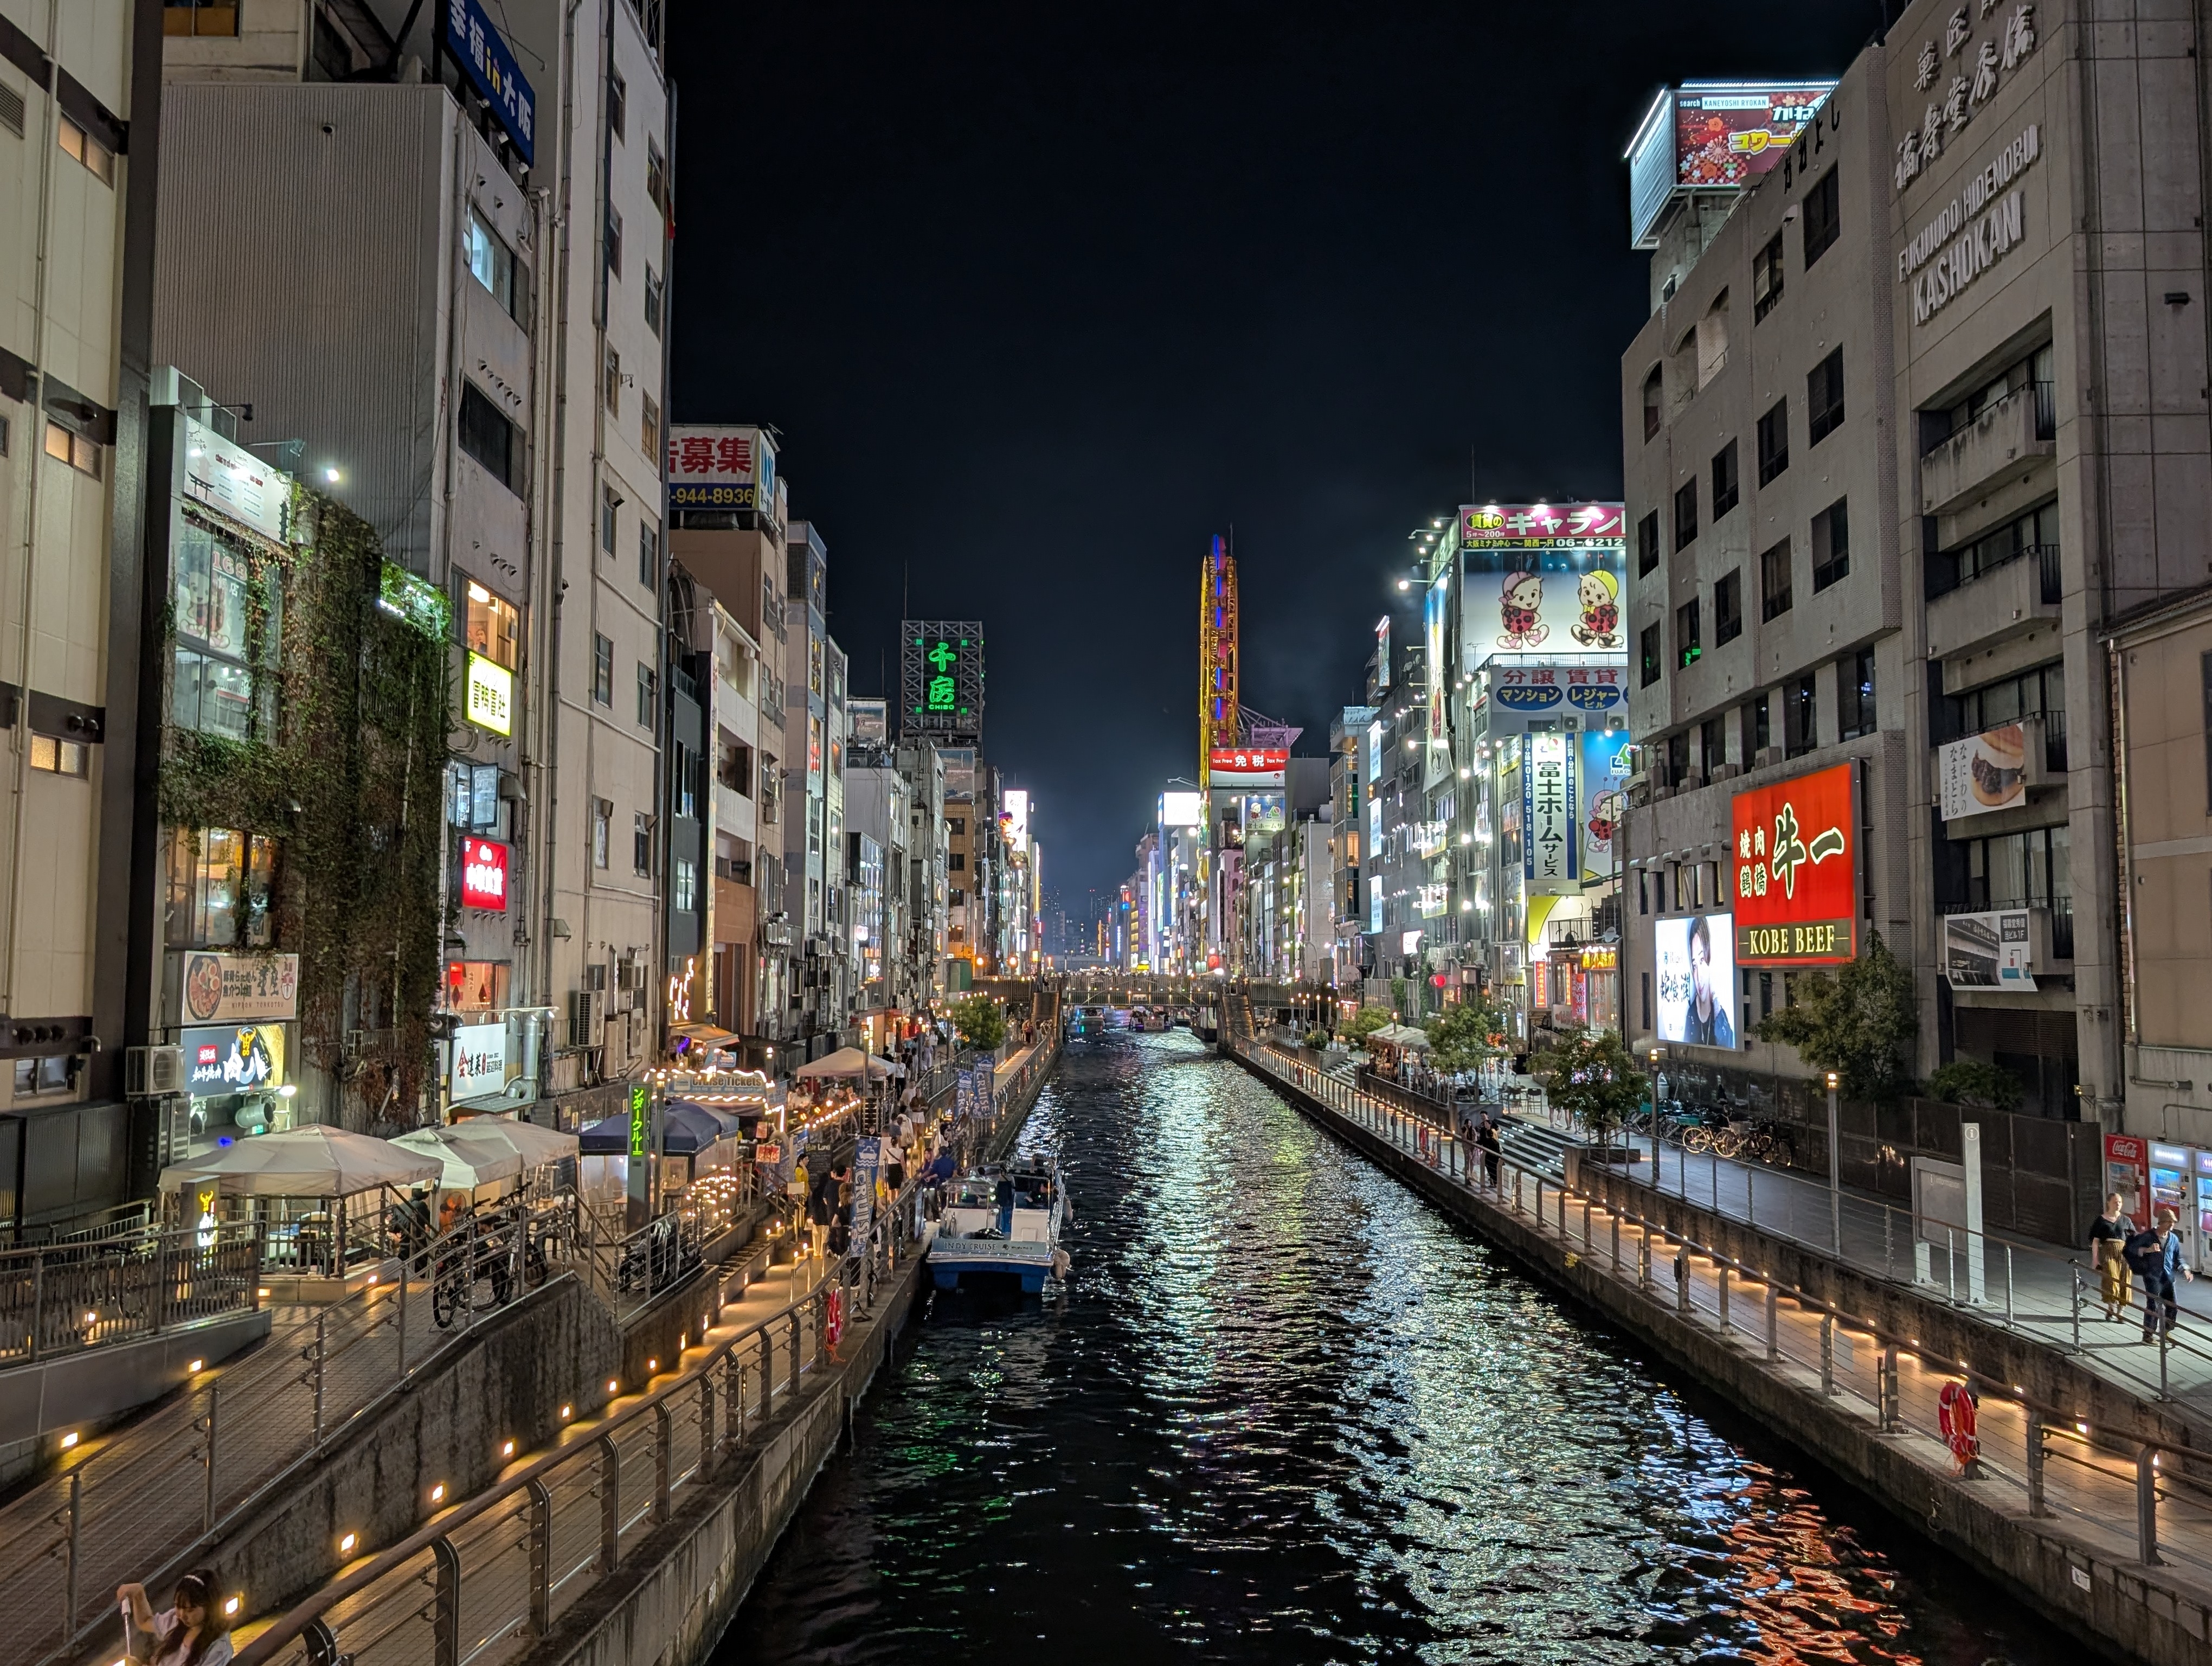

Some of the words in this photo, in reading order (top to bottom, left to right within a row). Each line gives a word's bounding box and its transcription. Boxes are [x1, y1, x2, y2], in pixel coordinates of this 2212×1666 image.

[1729, 129, 1800, 154] コワー
[1899, 199, 1960, 283] FUKUJUDO
[1963, 124, 2039, 221] HIDENOBU
[1914, 191, 2023, 325] KASHOKAN
[669, 488, 754, 504] -944-8936
[929, 643, 956, 703] 千房
[1501, 689, 1560, 702] マンション
[1572, 688, 1618, 701] レジャー
[1235, 755, 1264, 767] 免税
[1537, 761, 1563, 876] 富士ホームサービス
[1739, 826, 1765, 858] 焼肉
[1772, 803, 1844, 900] 牛一
[1740, 863, 1767, 898] 鶴橋
[1750, 929, 1789, 954] KOBE
[1795, 925, 1835, 953] BEEF
[726, 1077, 762, 1086] Tickets
[977, 1072, 991, 1111] CRUISE
[855, 1168, 871, 1245] CRUISE
